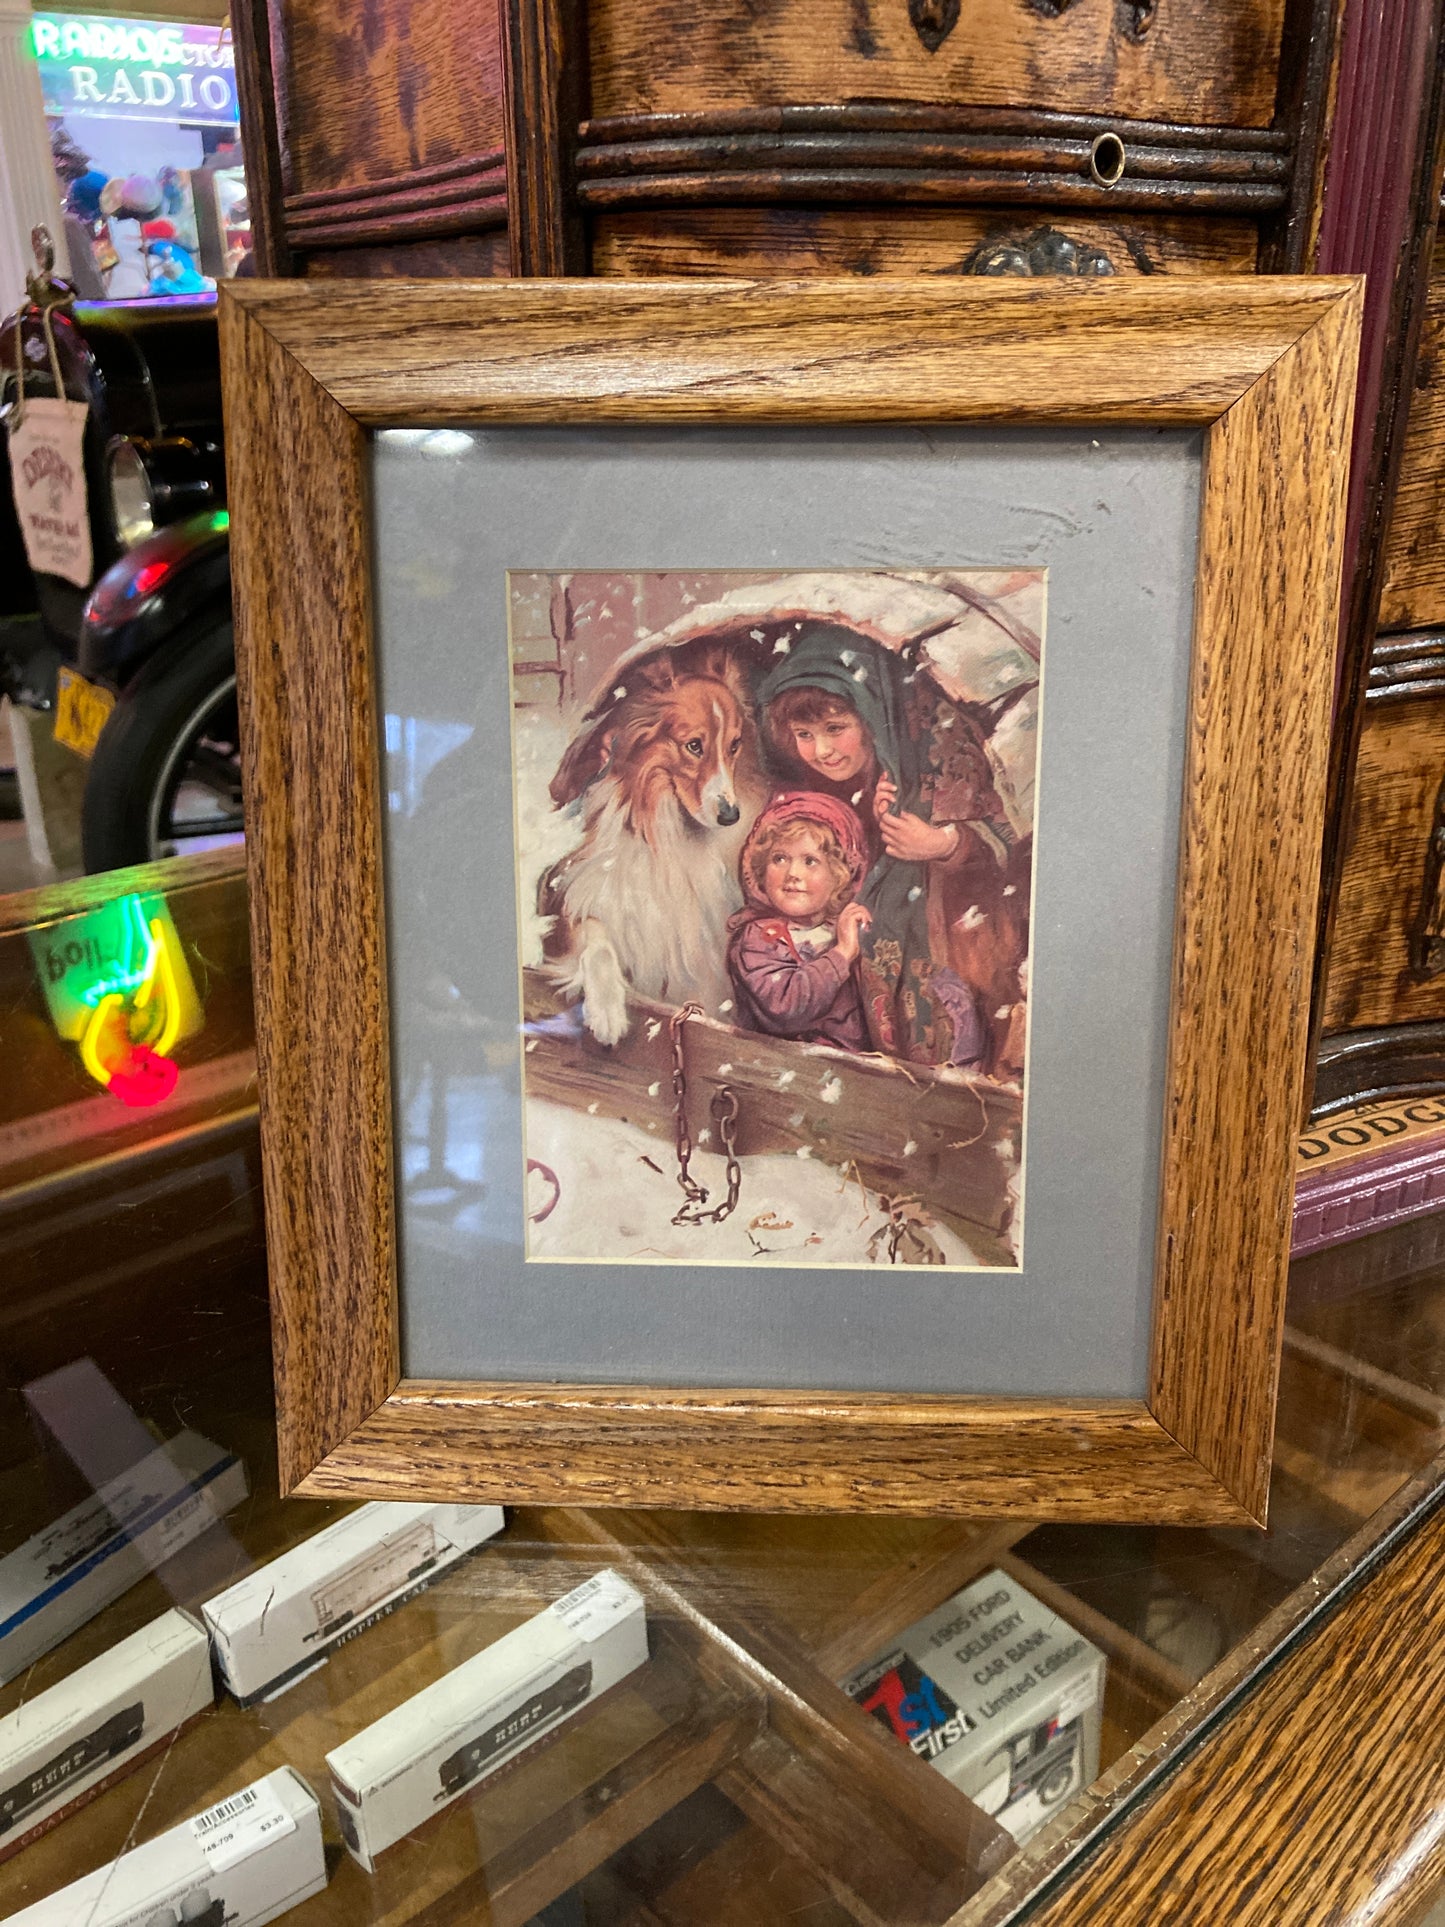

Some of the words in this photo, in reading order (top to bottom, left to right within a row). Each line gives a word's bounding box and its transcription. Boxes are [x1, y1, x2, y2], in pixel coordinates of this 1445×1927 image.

[69, 66, 232, 110] RADIO
[1298, 1101, 1445, 1159] DODG
[968, 1590, 1011, 1623] FORD
[956, 1612, 1024, 1662] DELIVERY
[973, 1657, 1008, 1686] CAR
[1005, 1629, 1052, 1663] BANK
[977, 1672, 1037, 1719] Limited
[1033, 1639, 1088, 1678] Edition
[908, 1709, 972, 1759] First
